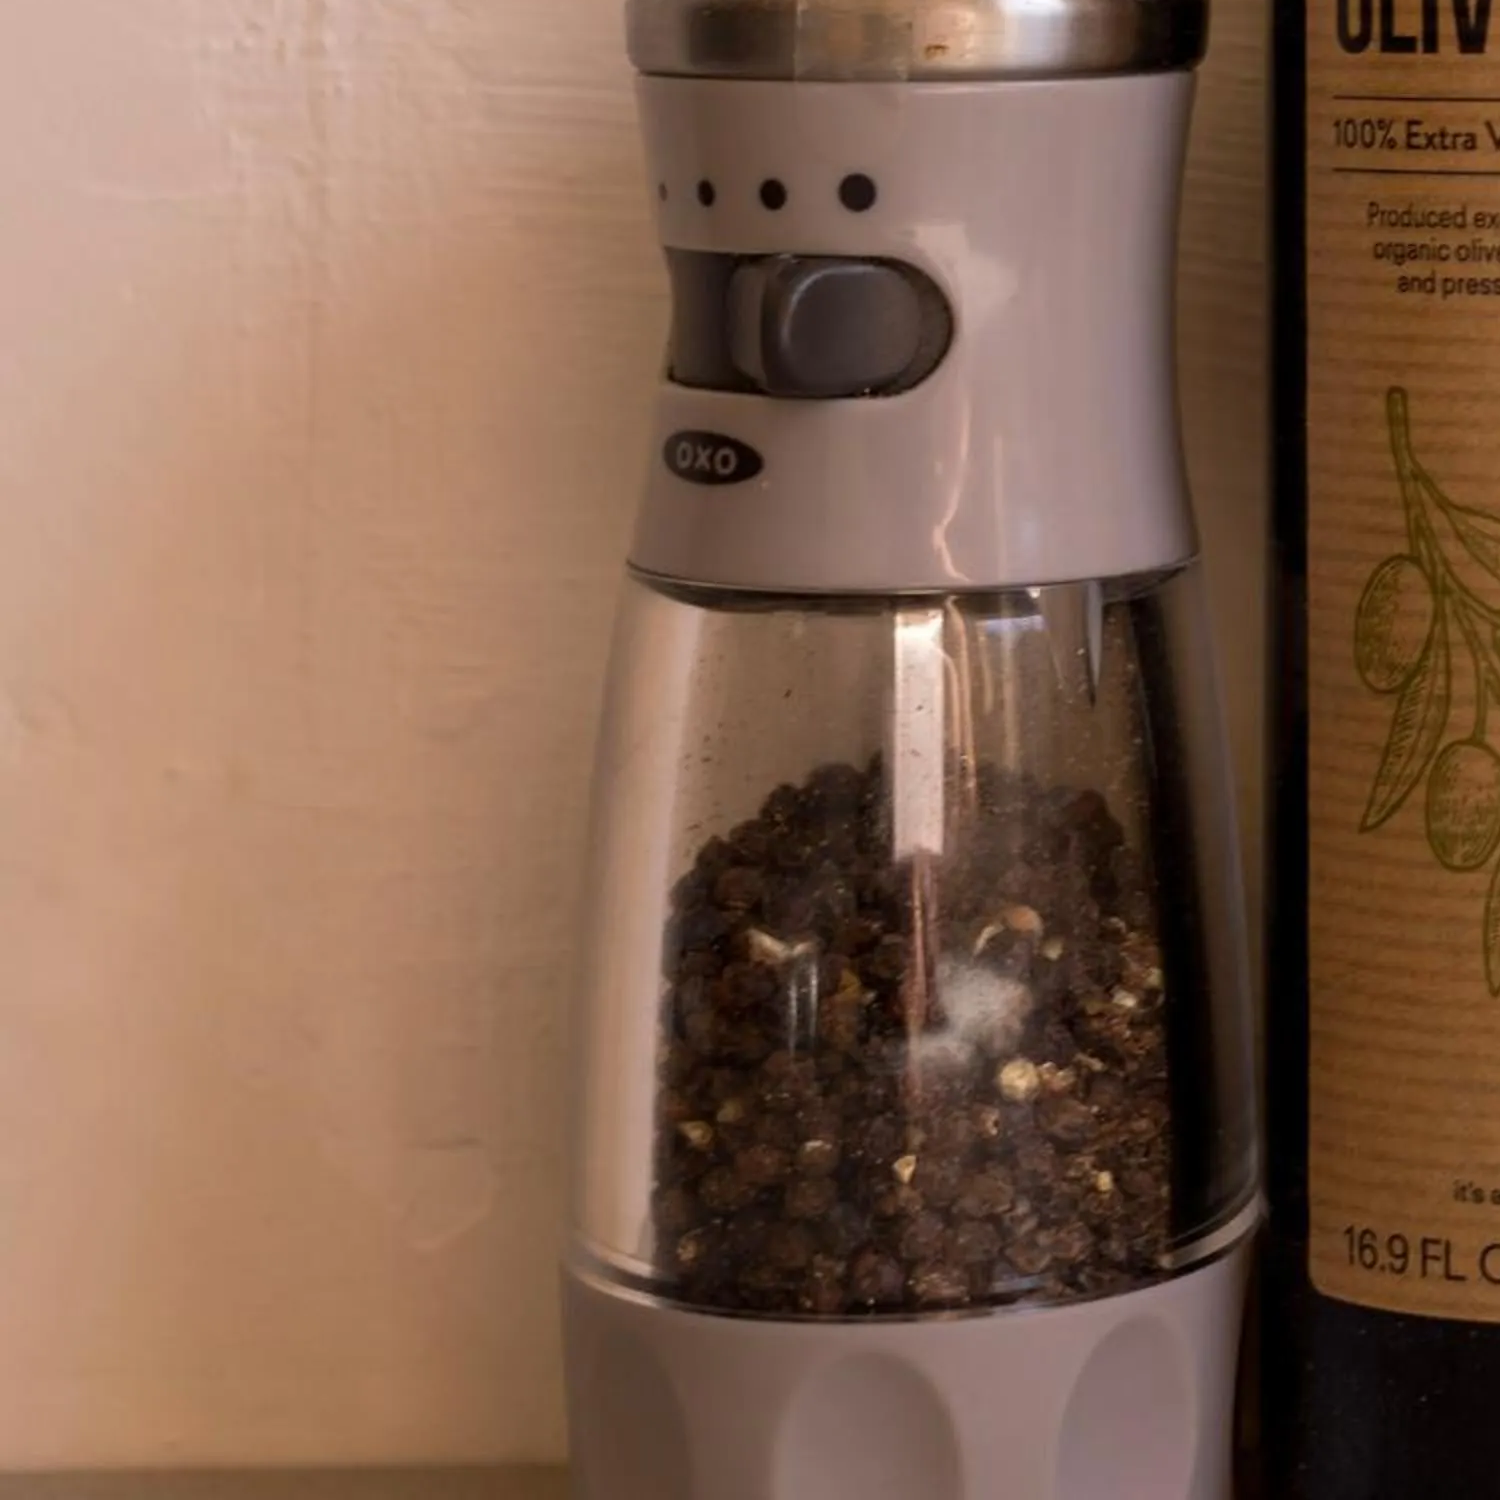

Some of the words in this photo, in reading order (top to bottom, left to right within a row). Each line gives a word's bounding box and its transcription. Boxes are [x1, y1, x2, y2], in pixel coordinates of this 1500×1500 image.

[1333, 120, 1397, 151] 100%
[1405, 120, 1477, 153] Extra
[1367, 202, 1467, 230] Produced
[1373, 238, 1450, 267] organic
[1397, 273, 1437, 295] and
[675, 440, 738, 476] OXO
[1453, 1180, 1486, 1204] it's
[1343, 1226, 1410, 1276] 16.9
[1420, 1237, 1467, 1283] FL
